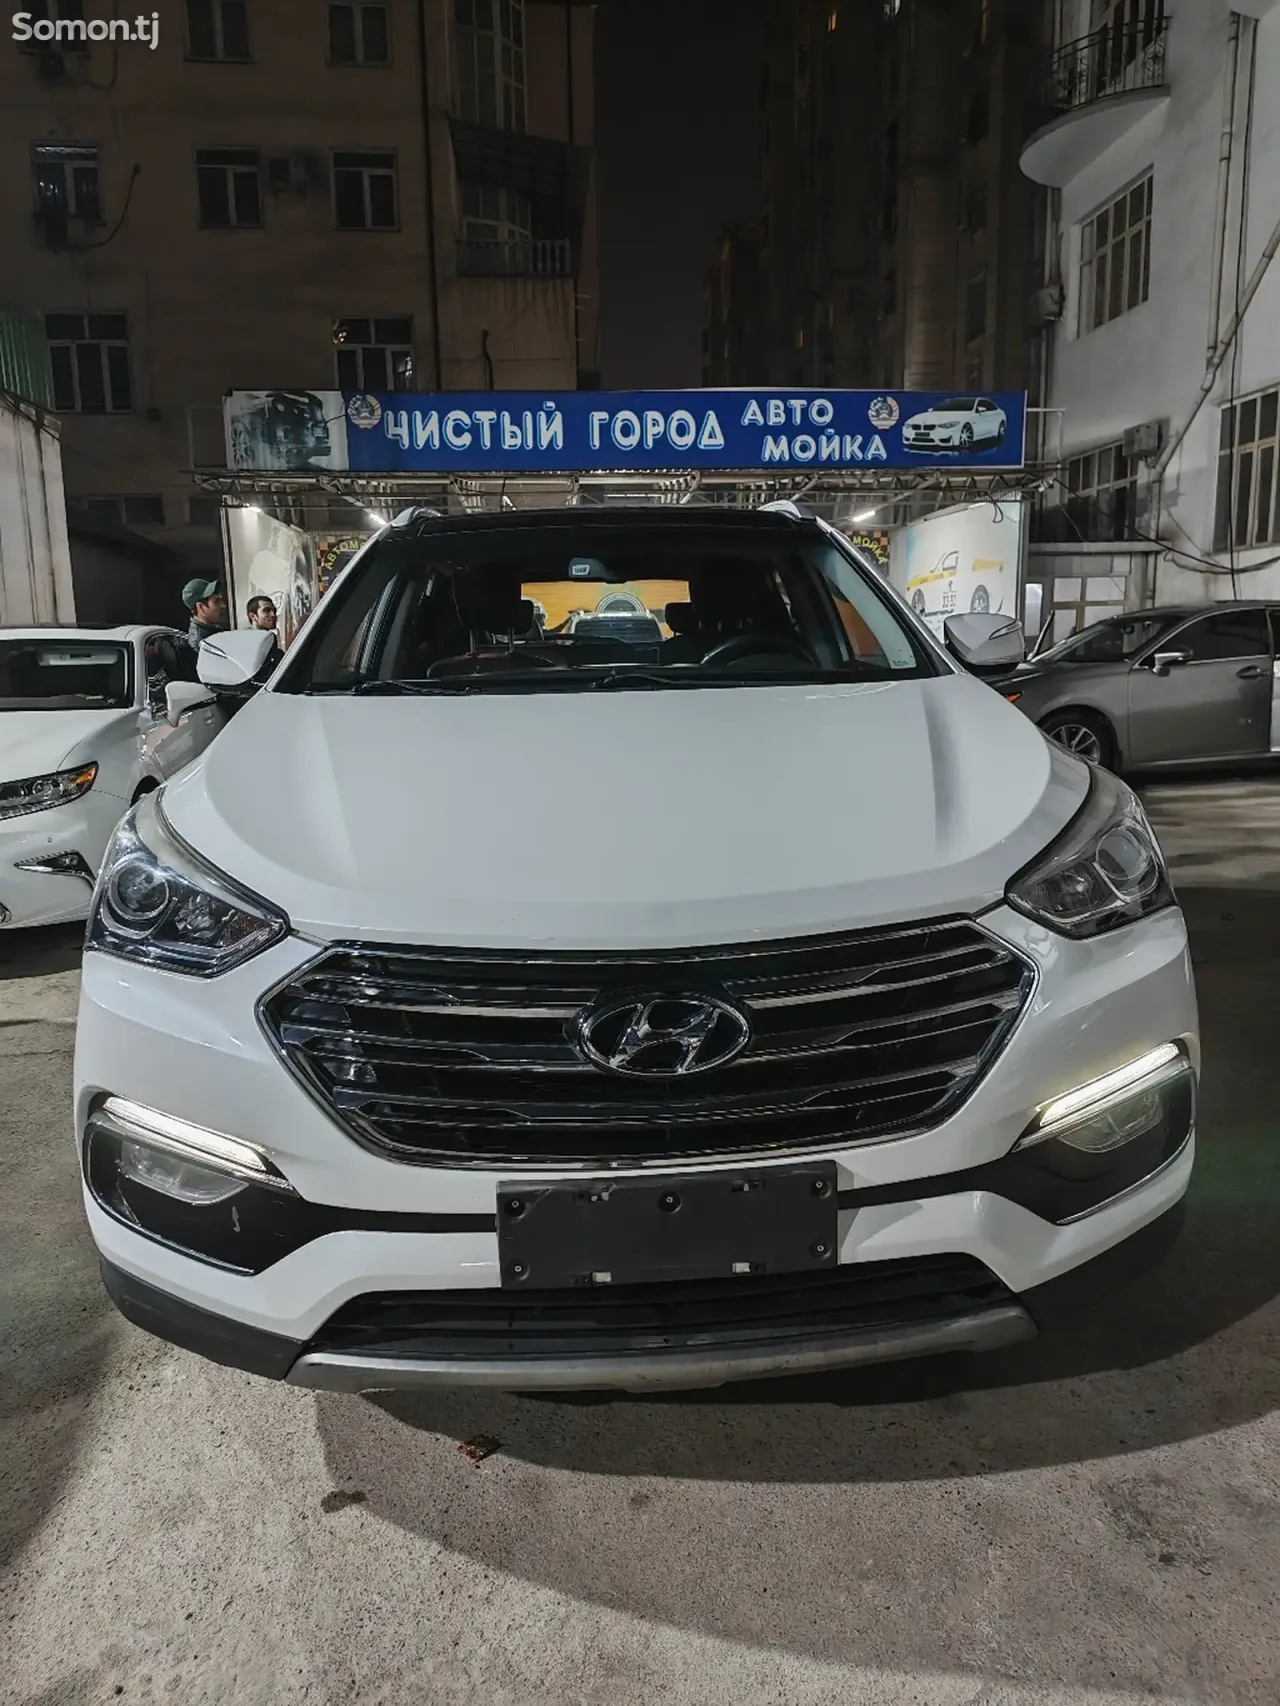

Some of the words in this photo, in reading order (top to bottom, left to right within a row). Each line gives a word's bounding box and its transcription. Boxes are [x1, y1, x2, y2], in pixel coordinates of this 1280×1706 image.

[384, 400, 564, 451] ЧИСТЫЙ
[589, 409, 725, 451] ГОРОД
[740, 398, 834, 426] АВТО
[761, 428, 888, 462] МОЙКА
